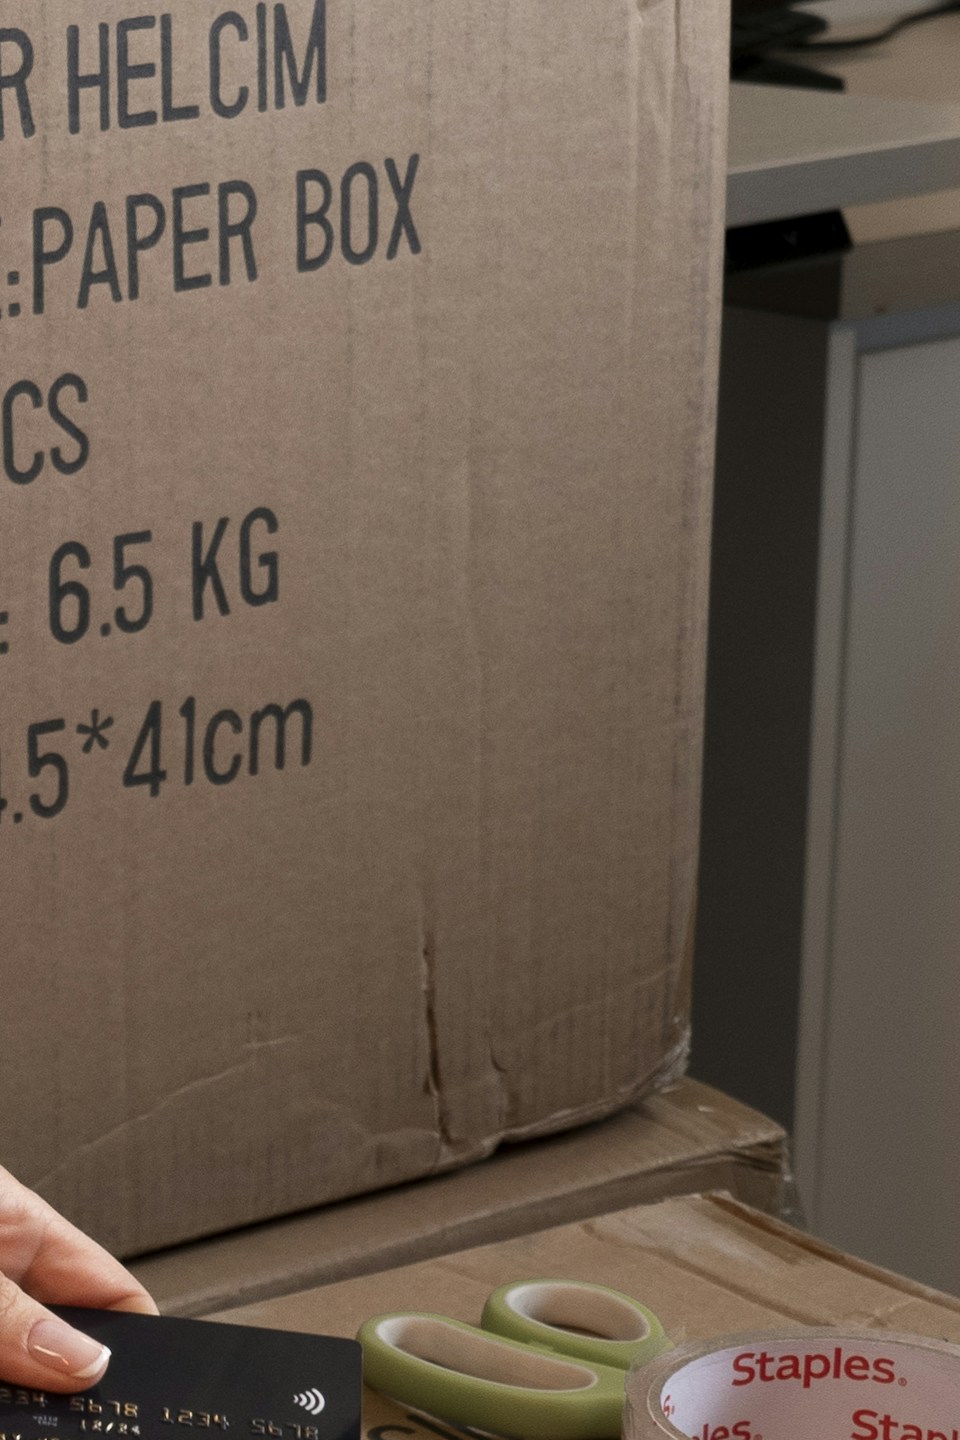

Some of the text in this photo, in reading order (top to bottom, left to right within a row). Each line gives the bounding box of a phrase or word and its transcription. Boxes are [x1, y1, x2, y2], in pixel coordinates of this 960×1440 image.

[67, 0, 327, 134] HELCIM
[296, 154, 421, 274] BOX
[49, 530, 153, 644] 6.5
[191, 507, 279, 621] KG
[69, 1396, 139, 1418] 5678
[162, 1406, 230, 1430] 1234
[251, 1418, 319, 1440] 5678
